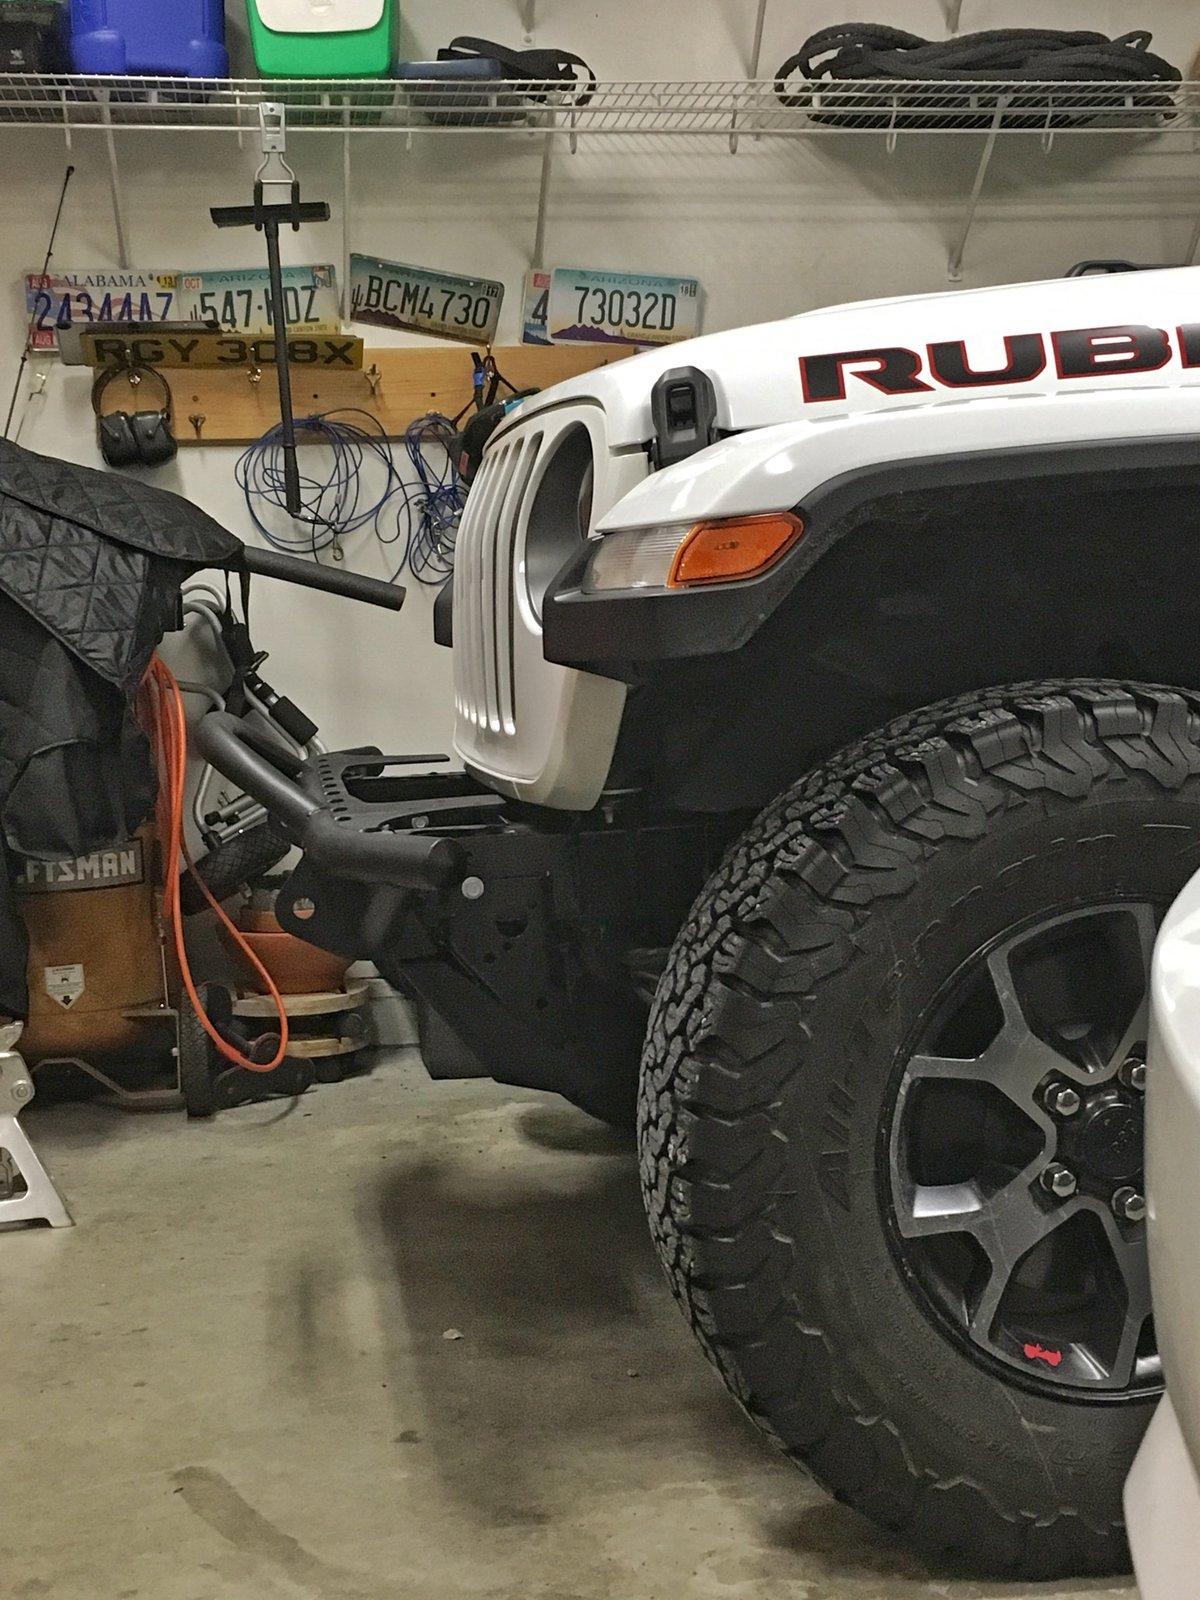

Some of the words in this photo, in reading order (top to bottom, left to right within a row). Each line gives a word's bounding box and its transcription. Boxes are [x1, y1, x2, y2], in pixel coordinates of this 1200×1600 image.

[63, 274, 146, 288] ALABAMA
[184, 277, 201, 289] OCT
[219, 271, 296, 283] ARIZOA
[364, 275, 491, 329] BCM4730
[574, 285, 677, 331] 73032D
[93, 338, 200, 364] RGY
